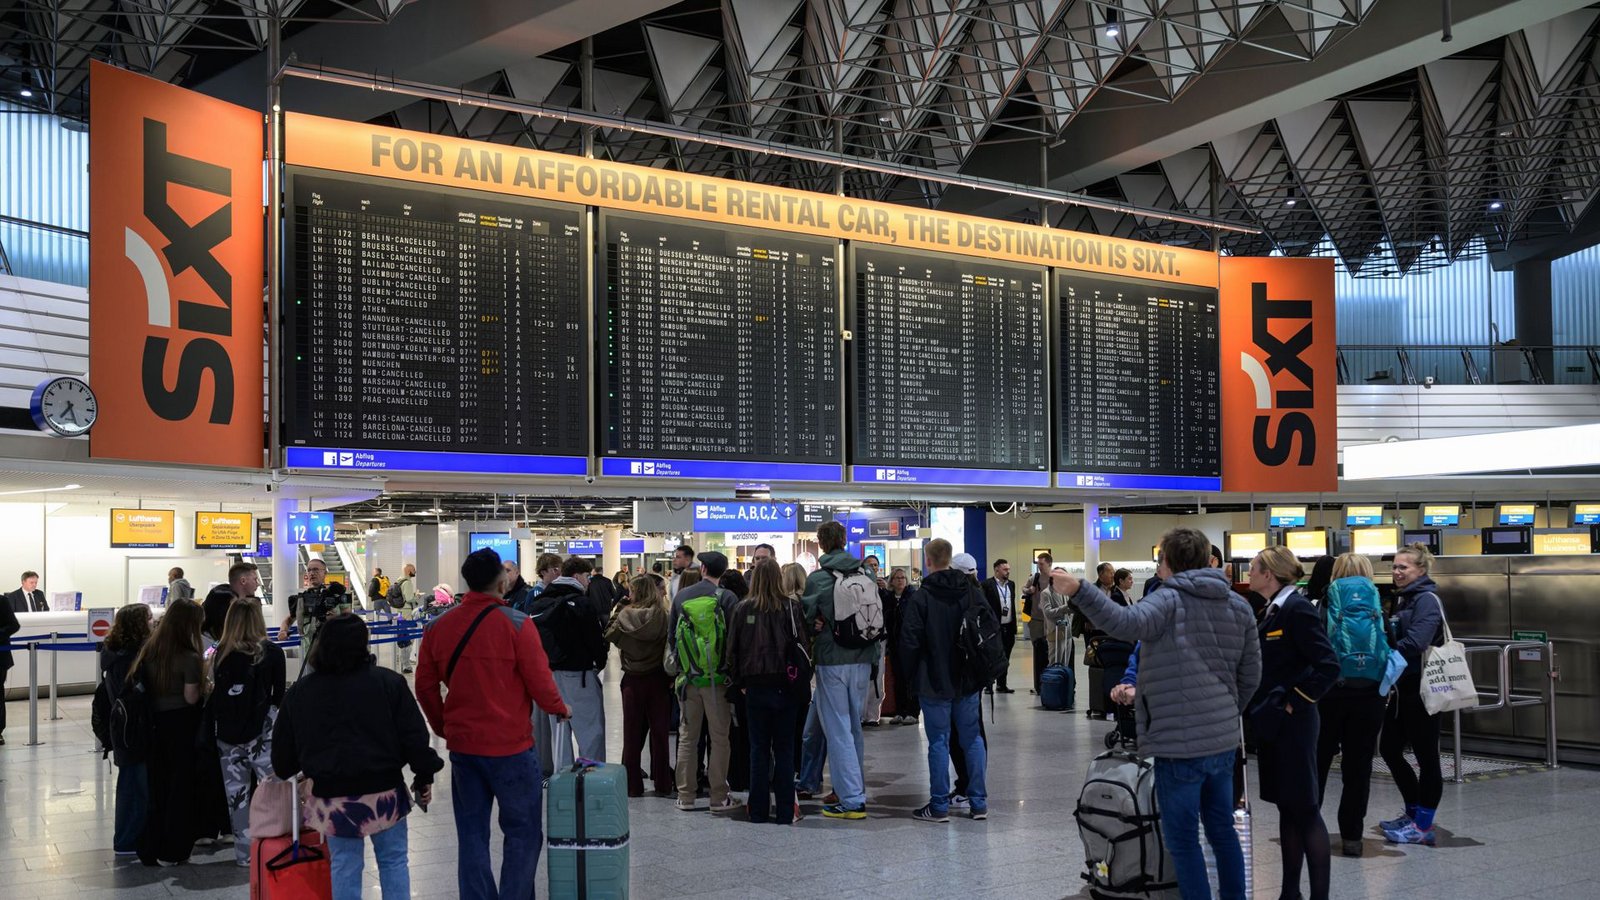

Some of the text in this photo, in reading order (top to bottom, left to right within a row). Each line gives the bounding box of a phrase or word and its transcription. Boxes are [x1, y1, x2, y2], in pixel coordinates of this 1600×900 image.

[372, 135, 1181, 276] FOR AN AFFORDABLE RENTAL CAR, THE DESTINATION IS SIXT.
[362, 233, 436, 248] BERLIN-CANCELLED
[334, 238, 445, 258] 1004 BRUESSEL-CANCELLED
[334, 248, 431, 265] 1200 BASEL-CANCELLED
[125, 117, 235, 425] SIXT
[338, 257, 441, 275] 246 MAILAND-CANCELLED
[338, 266, 450, 284] 390 LUXEMBURG-CANCELLED
[660, 275, 718, 287] BERLIN-CANCELLED
[362, 278, 436, 292] DUBLIN-CANCELLED
[362, 287, 436, 301] BREMEN-CANCELLED
[362, 296, 427, 309] OSLO-CANCELLED
[362, 305, 385, 314] ATHEN
[338, 312, 445, 328] 040 HANNOVER-CANCELLED
[339, 321, 450, 337] 130 STUTTGART-CANCELLED
[362, 332, 450, 346] NUERNBERG-CANCELLED
[334, 339, 352, 347] 3600
[362, 342, 427, 353] DORTMUND-KOELN
[334, 348, 352, 356] 3640
[362, 351, 454, 364] HAMBURG-MUENSTER-OSN
[362, 360, 399, 369] MUENCHEN
[362, 369, 422, 379] ROM-CANCELLED
[1241, 282, 1316, 467] SIXT
[362, 378, 445, 389] WARSCHAU-CANCELLED
[362, 387, 450, 398] STOCKHOLM-CANCELLED
[334, 394, 427, 406] 1392 PRAG-CANCELLED
[363, 414, 431, 424] PARIS-CANCELLED
[363, 423, 450, 433] BARCELONA-CANCELLED
[363, 432, 450, 442] BARCELONA-CANCELLED
[656, 462, 671, 470] Abflug
[710, 512, 736, 520] Departures
[294, 526, 306, 541] 12
[317, 526, 331, 541] 12
[1109, 526, 1120, 538] 11
[1424, 659, 1446, 668] Keep
[1426, 667, 1444, 676] and
[1429, 674, 1467, 685] add more
[1431, 684, 1456, 694] hops.
